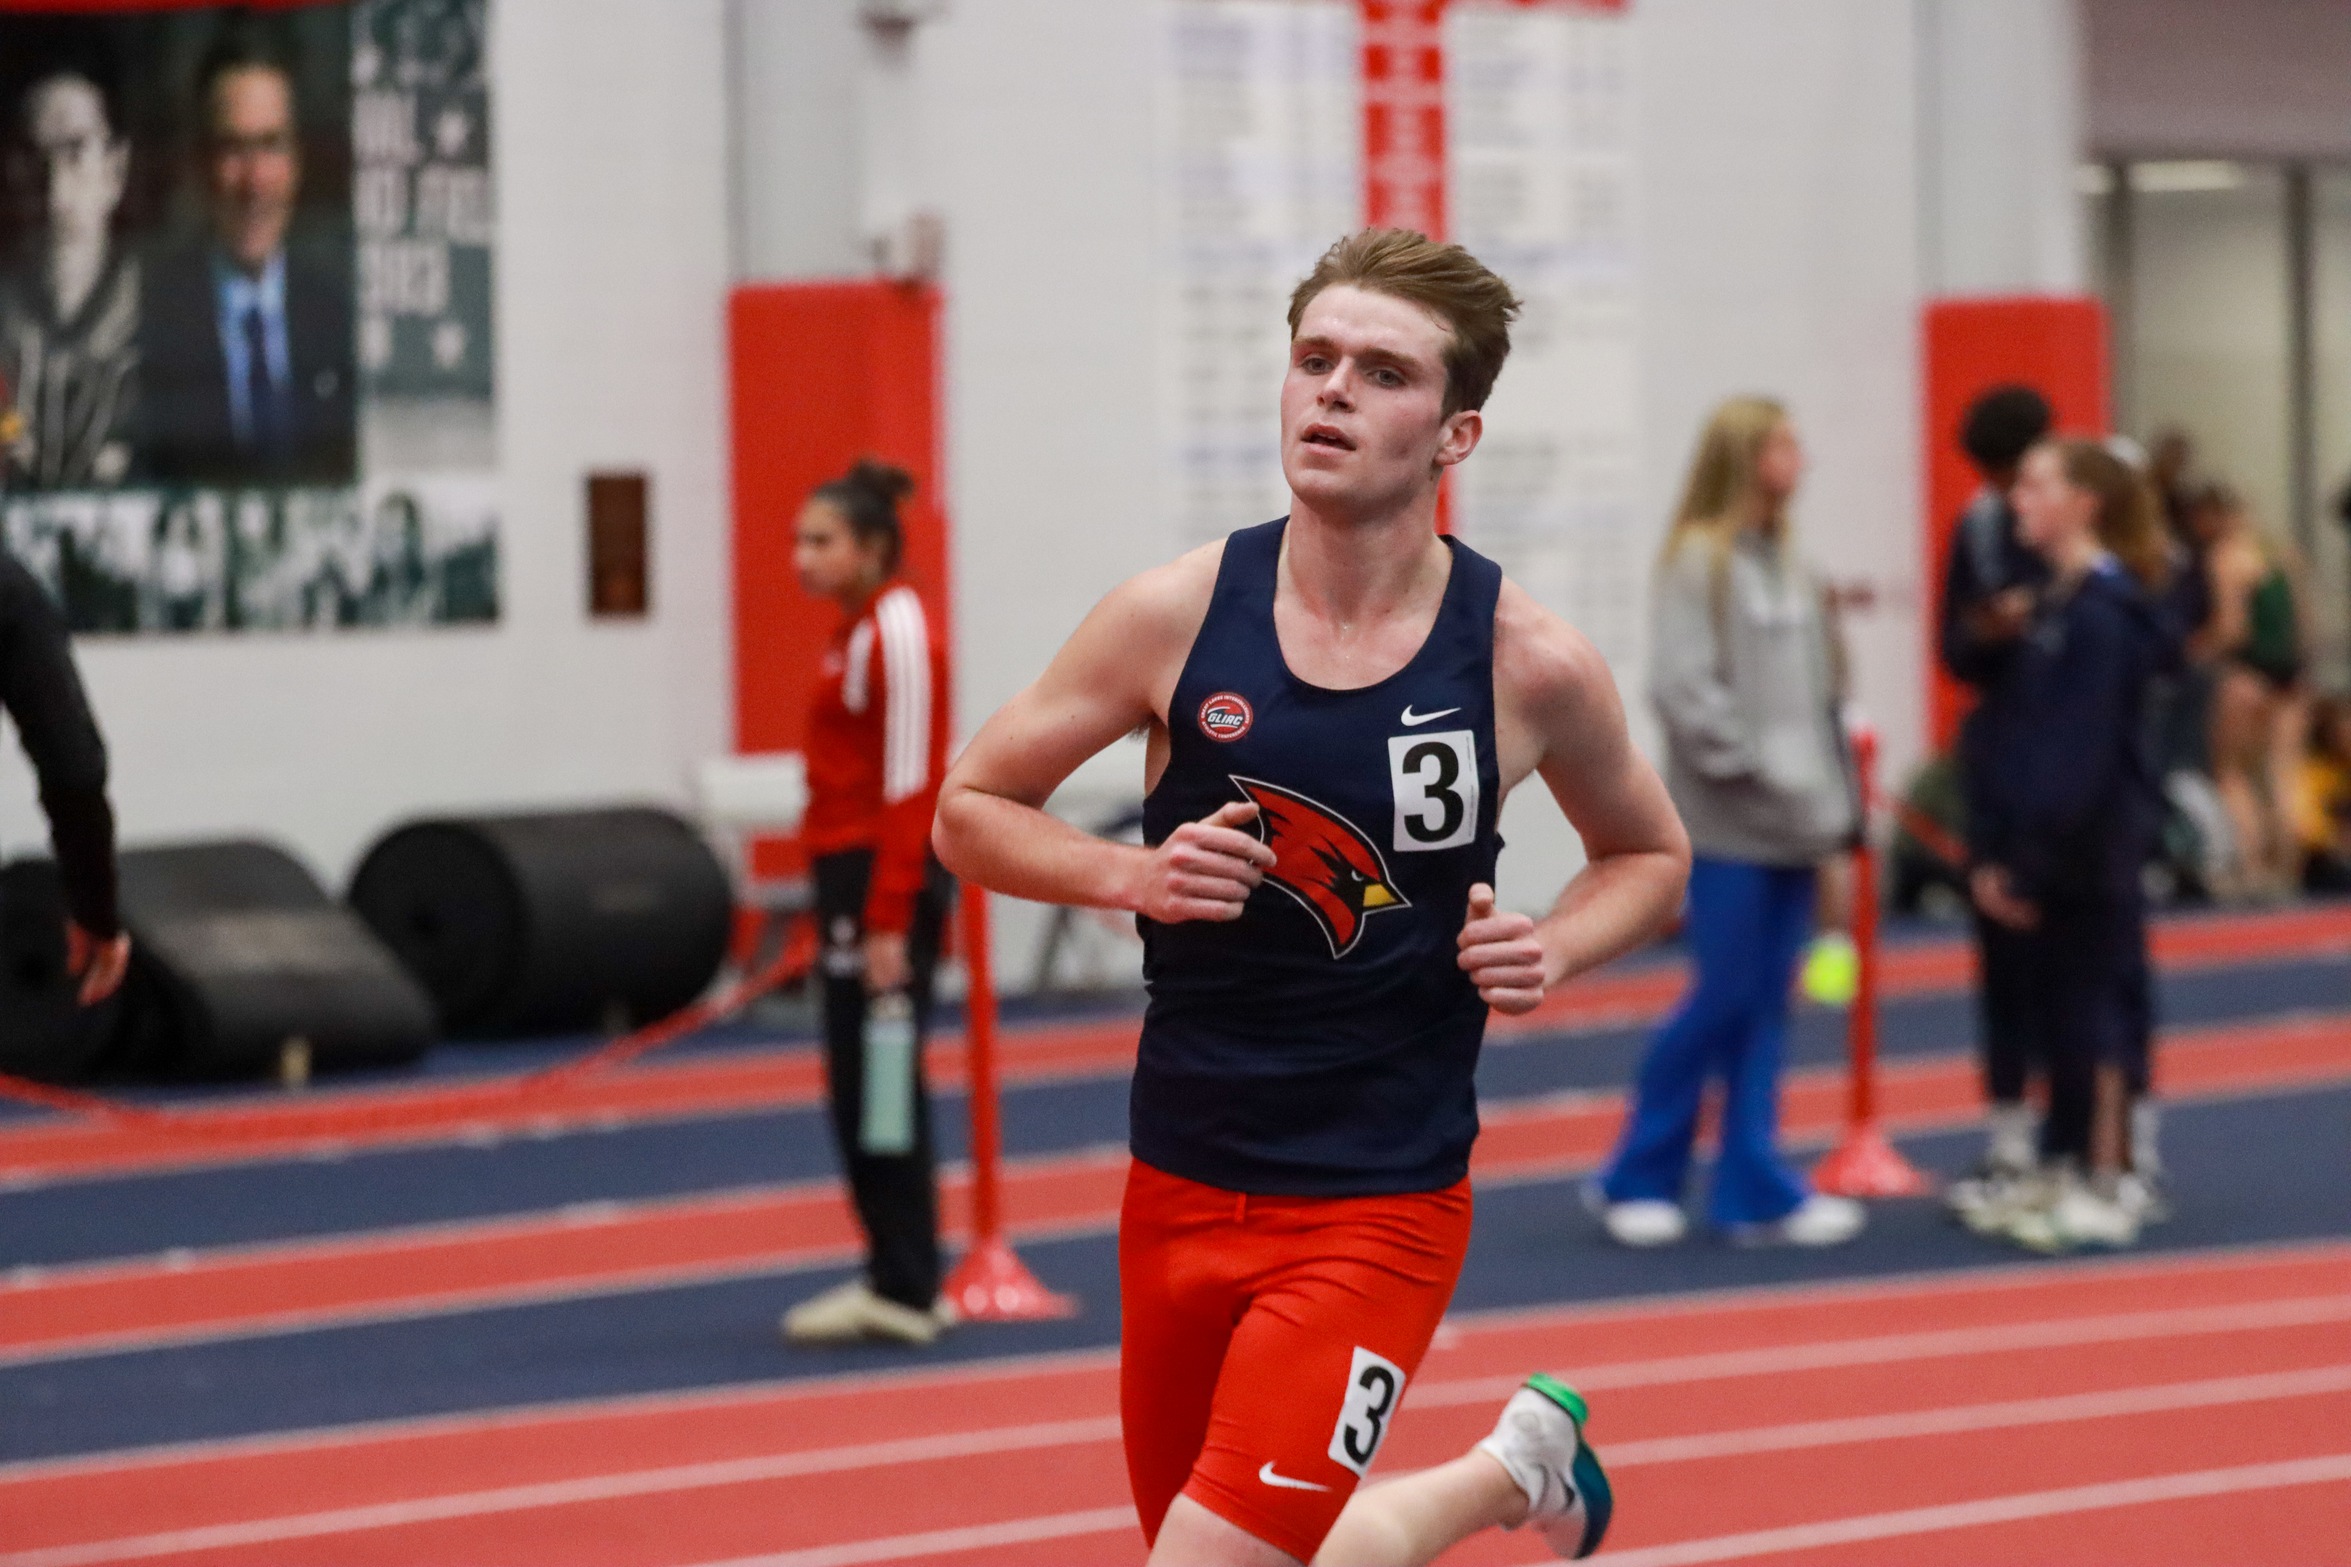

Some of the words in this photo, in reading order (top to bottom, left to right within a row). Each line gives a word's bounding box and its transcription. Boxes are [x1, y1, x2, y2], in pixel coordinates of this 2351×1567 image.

[1207, 713, 1243, 725] GLIAC
[1402, 741, 1464, 843] 3
[1344, 1365, 1395, 1466] 3
